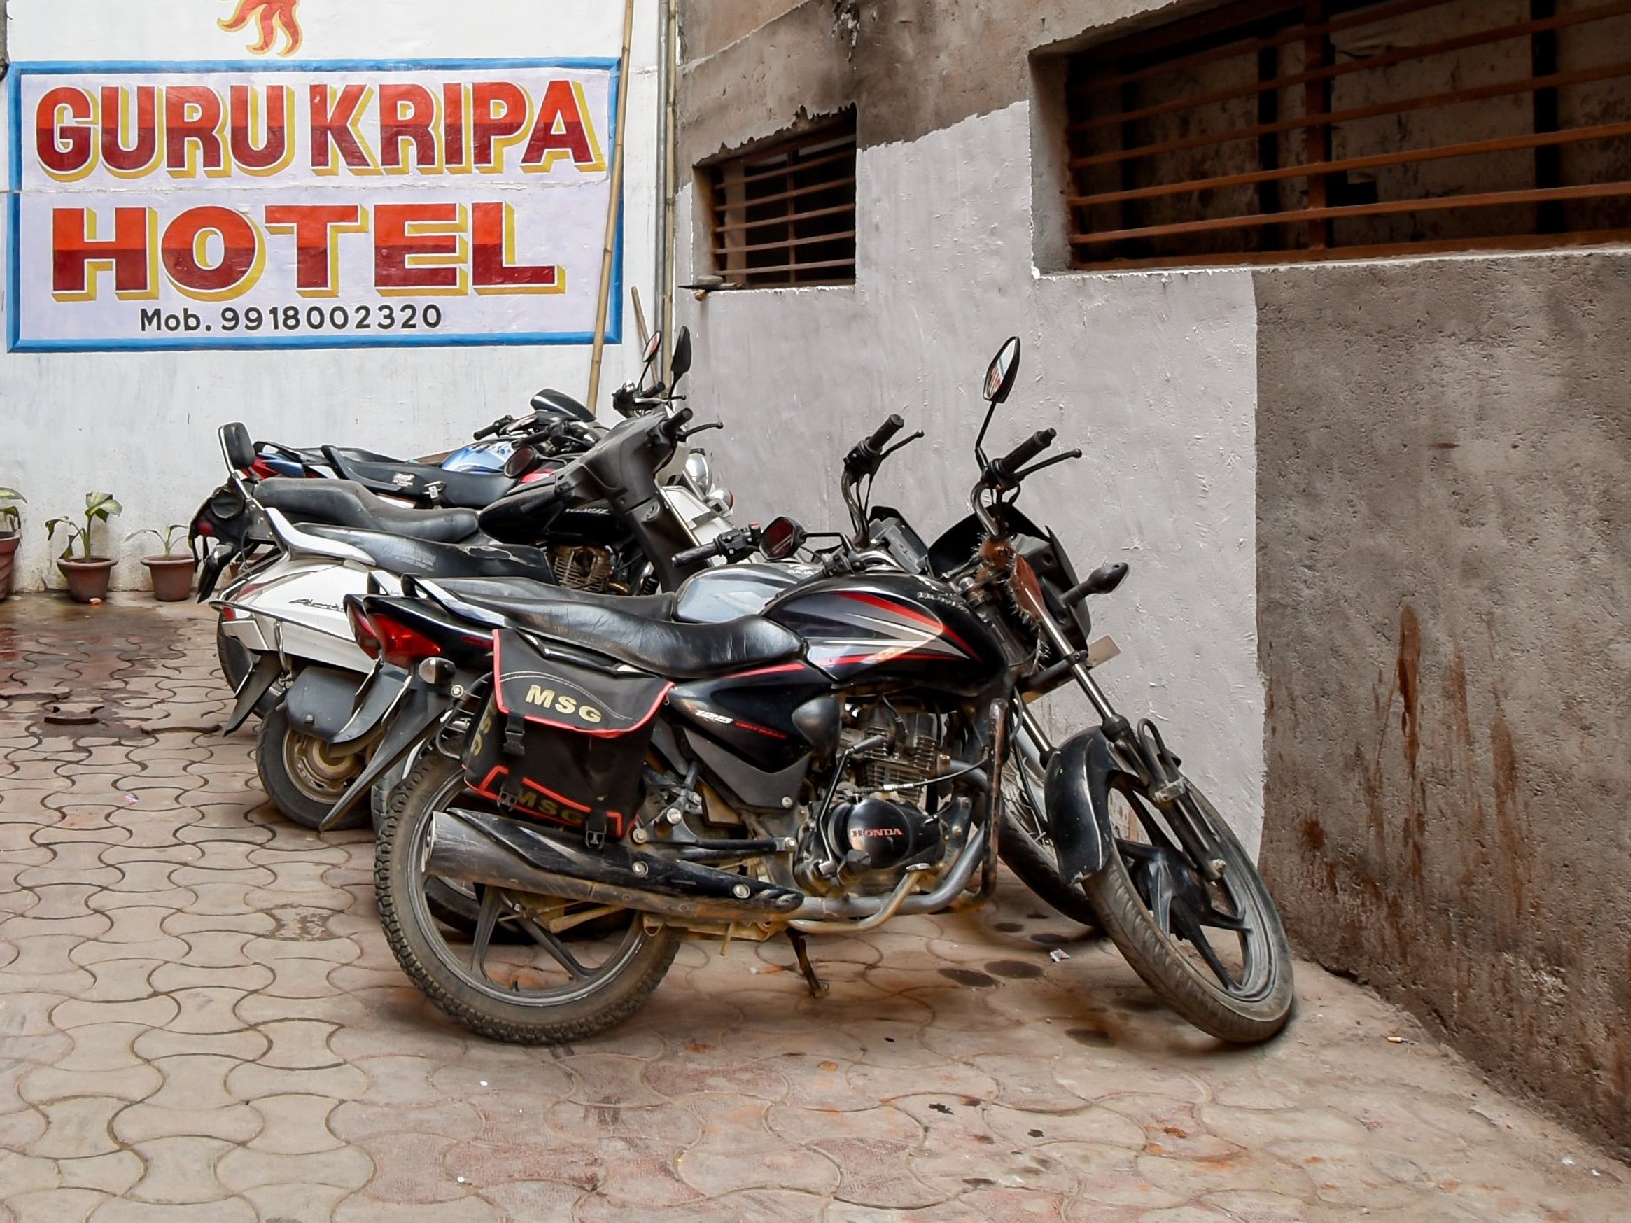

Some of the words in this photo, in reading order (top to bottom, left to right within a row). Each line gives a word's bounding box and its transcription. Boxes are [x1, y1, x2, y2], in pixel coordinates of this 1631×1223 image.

[34, 83, 295, 181] GURU
[309, 79, 606, 178] KRIPA
[50, 201, 566, 302] HOTEL
[139, 307, 213, 332] Mob.
[220, 304, 443, 331] 9918002320
[525, 684, 602, 723] MSG
[850, 827, 903, 838] HONDA
